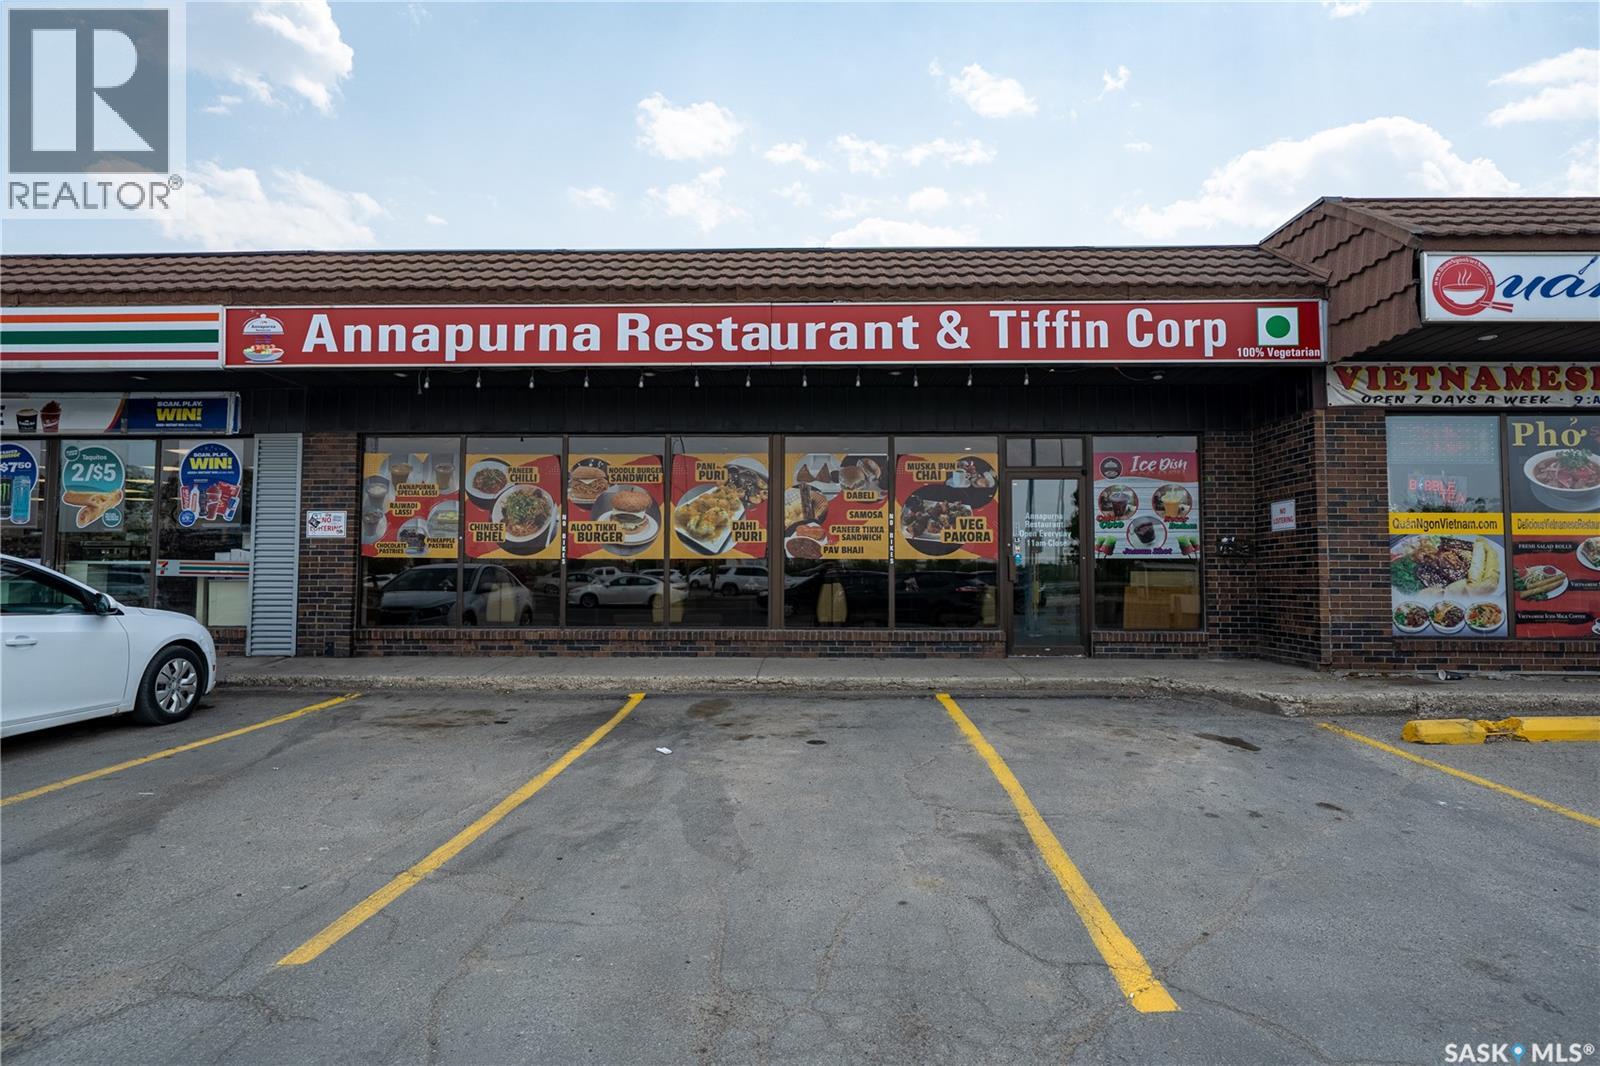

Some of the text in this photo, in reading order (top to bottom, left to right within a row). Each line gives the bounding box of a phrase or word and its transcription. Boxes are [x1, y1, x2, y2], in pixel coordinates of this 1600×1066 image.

[301, 307, 1227, 362] Annapurna Restaurant & Tiffin Corp
[1236, 346, 1321, 359] 100% Vegetarian
[1361, 394, 1406, 405] OPEN
[1414, 394, 1423, 405] 7
[1431, 394, 1477, 405] DAYS
[1484, 394, 1495, 405] A
[1503, 394, 1551, 405] WEEK
[156, 408, 202, 421] WIN!
[190, 457, 233, 469] WIN!
[1130, 455, 1188, 473] Ice Dish
[71, 463, 117, 483] 2/$5
[509, 474, 537, 482] CHILLI
[610, 474, 659, 482] SANDWICH
[699, 470, 725, 480] PURI
[916, 470, 941, 481] CHAI
[846, 491, 874, 499] DABELI
[849, 511, 883, 519] SAMOSA
[469, 523, 503, 531] CHINESE
[571, 523, 617, 531] ALOO TIKKI
[732, 522, 756, 531] DAHI
[959, 519, 984, 530] VEG
[476, 532, 504, 541] BHEL
[577, 532, 623, 542] BURGER
[735, 531, 761, 541] PURI
[944, 532, 991, 542] PAKORA
[823, 546, 864, 554] PAV BHAJI
